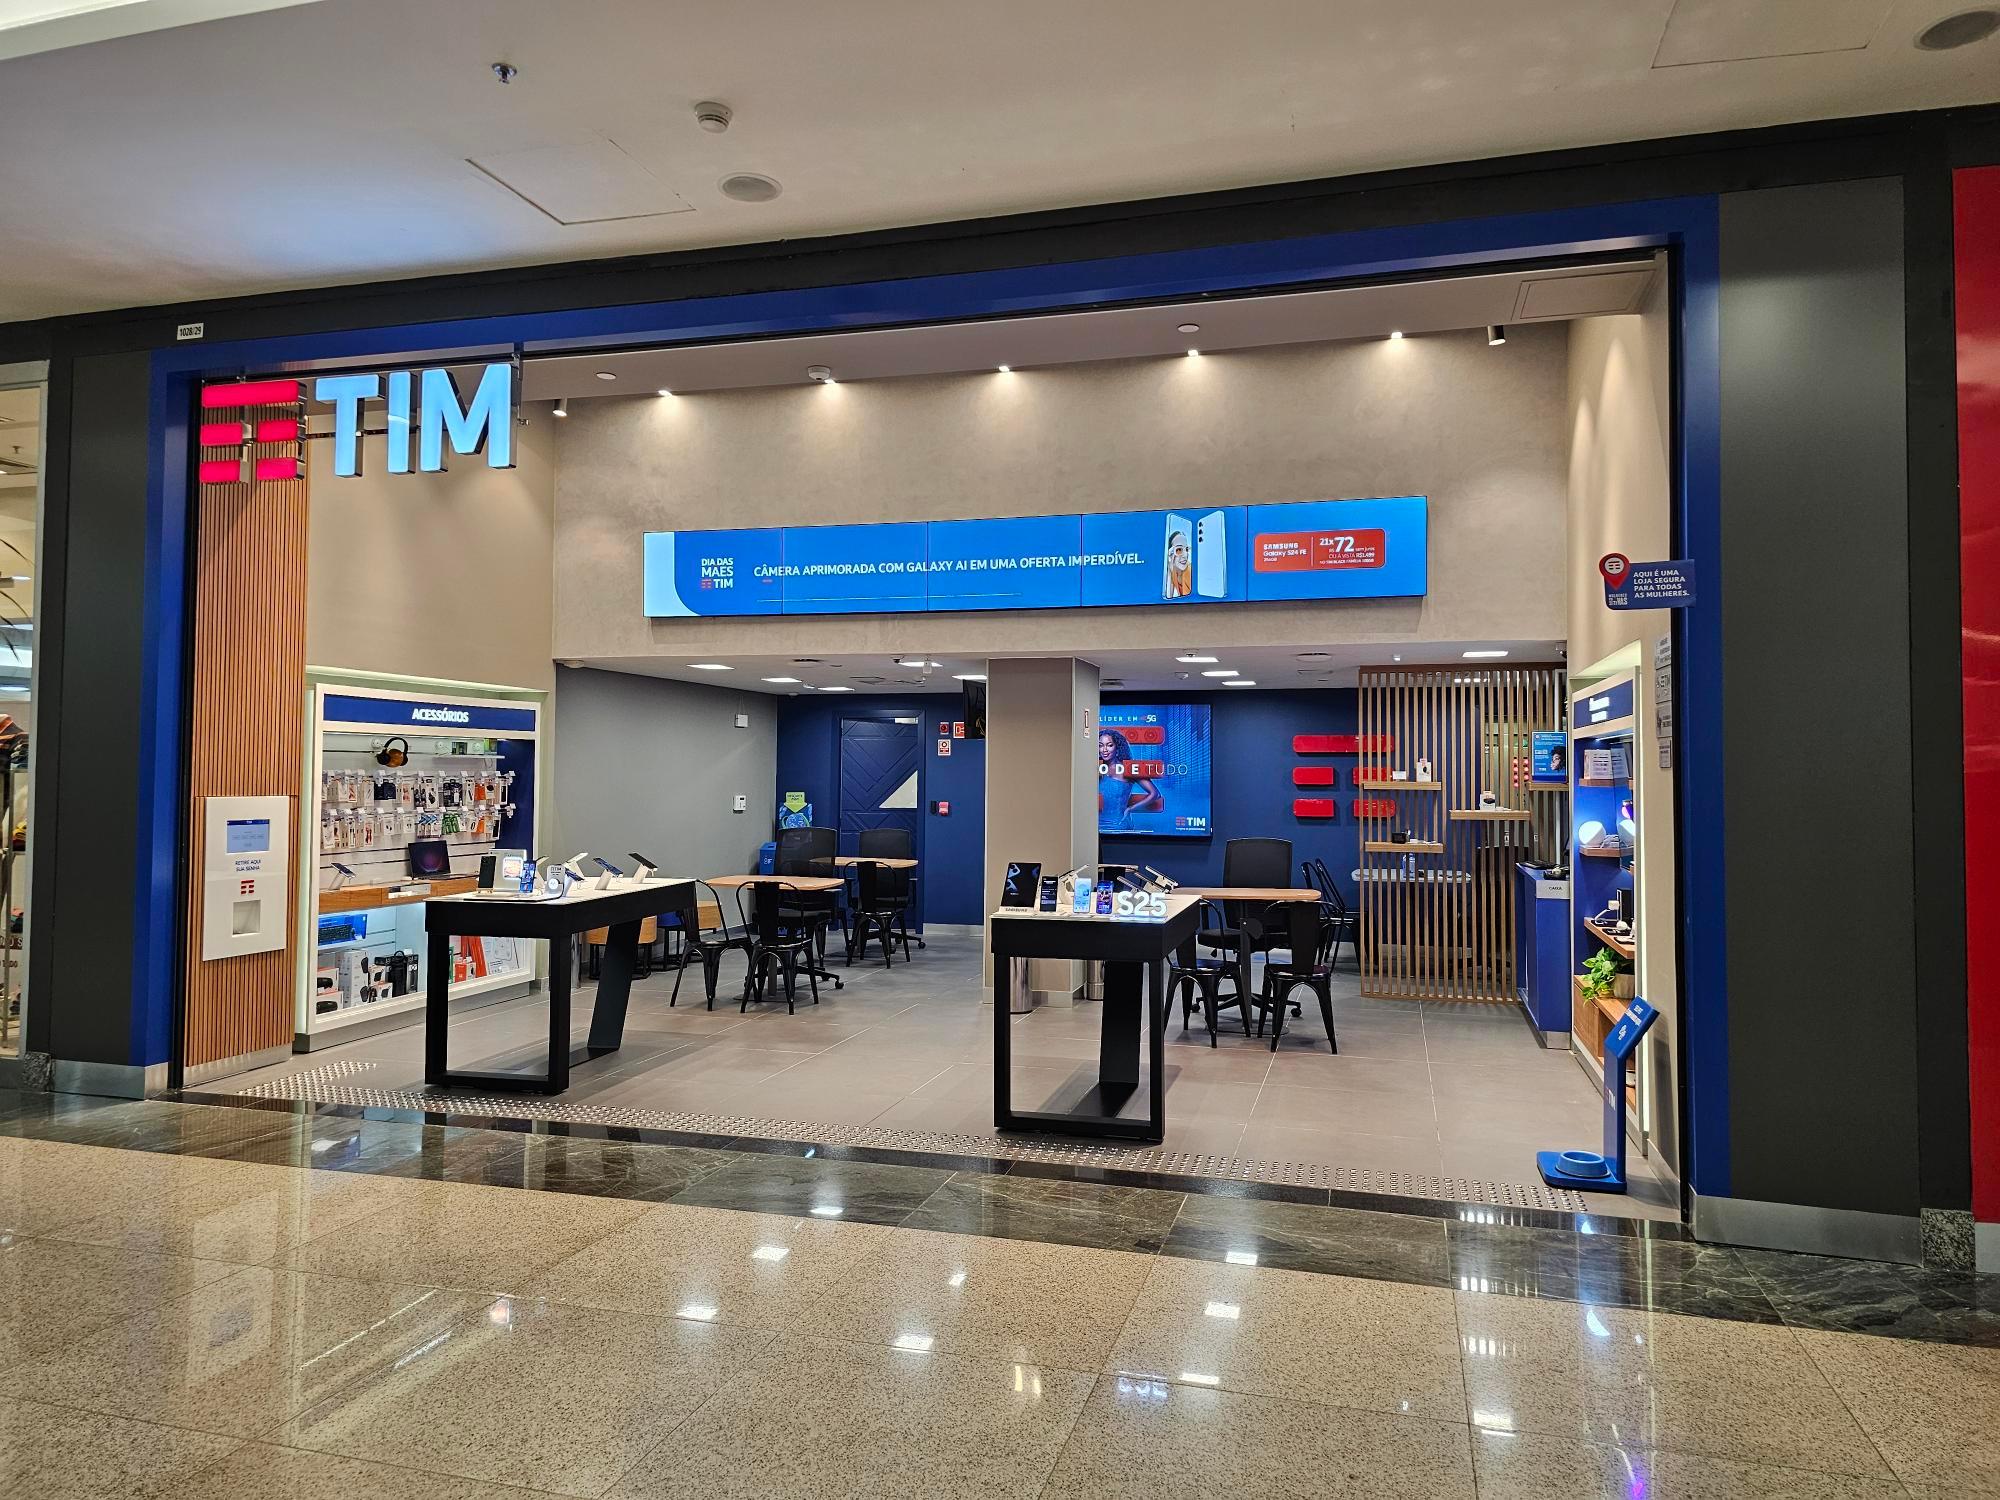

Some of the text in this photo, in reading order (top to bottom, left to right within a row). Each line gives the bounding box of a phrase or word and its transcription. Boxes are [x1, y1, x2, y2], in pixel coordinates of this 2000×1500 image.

[316, 363, 516, 478] TIM
[1334, 536, 1354, 552] 72
[701, 557, 734, 566] DIA DAS
[753, 551, 1145, 577] CÂMERA APRIMORADA COM GALAXY AI EM UMA OFERTA IMPERDÍVEL.
[713, 578, 733, 588] TIM
[412, 708, 469, 723] ACESSÓRIOS
[1099, 764, 1139, 774] ODE
[1187, 817, 1206, 827] TIM
[1117, 890, 1168, 916] S25
